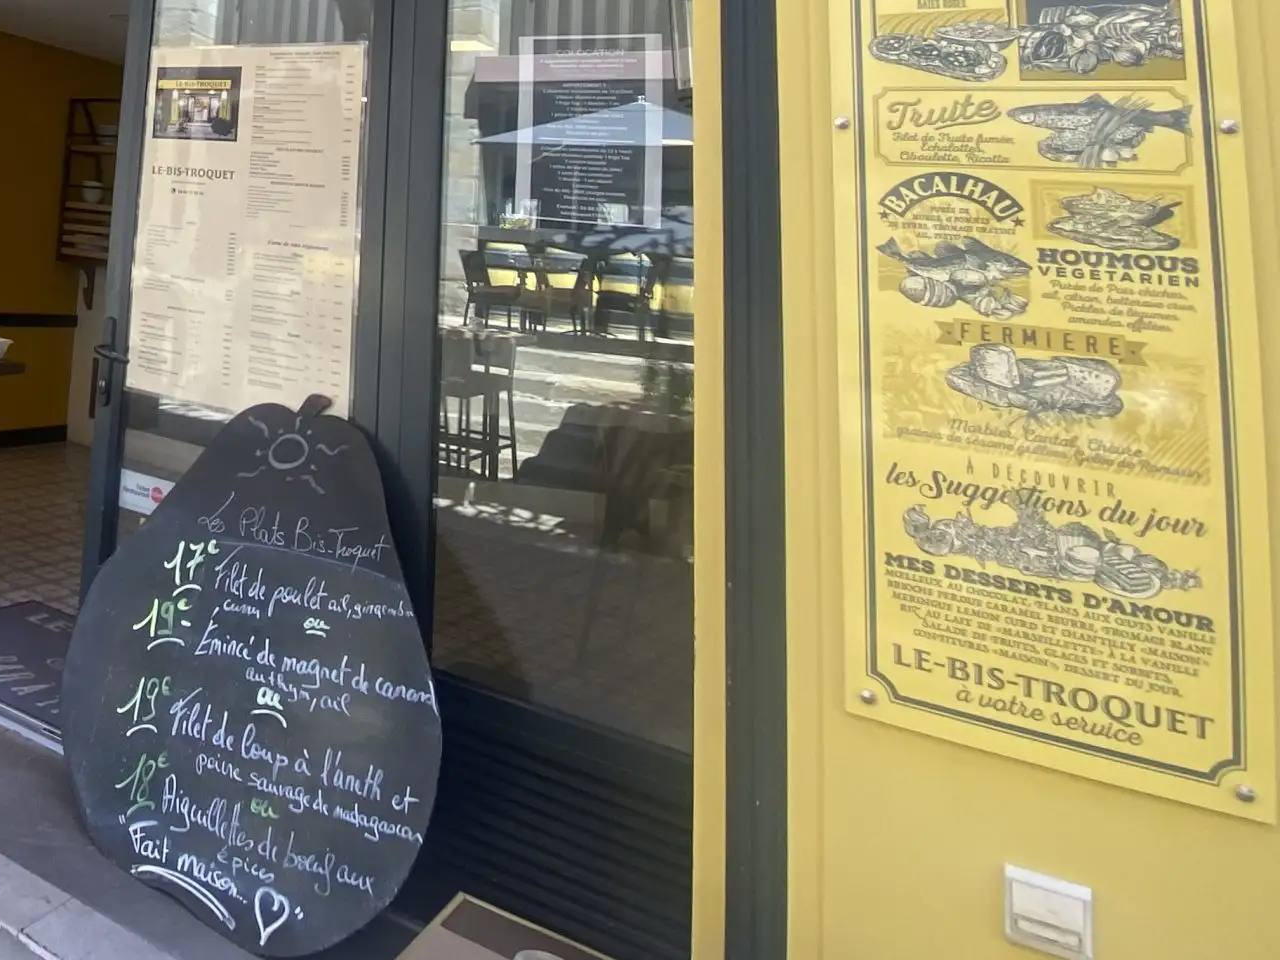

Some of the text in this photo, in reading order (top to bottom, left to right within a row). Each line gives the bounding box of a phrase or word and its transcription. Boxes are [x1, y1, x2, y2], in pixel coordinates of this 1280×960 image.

[886, 94, 1002, 130] Truite
[921, 132, 935, 144] de
[152, 165, 236, 181] LE-BIS-TROQUET
[883, 175, 1019, 217] BACALHAU
[1036, 247, 1200, 274] HOUMOUS
[1037, 265, 1199, 288] VEGETARIEN
[959, 323, 1122, 356] FERMIERE
[885, 462, 1207, 538] les Suggestions du jour
[239, 505, 286, 547] Plats
[293, 517, 391, 574] Bis-Troquet
[214, 544, 246, 598] Filet
[247, 570, 266, 602] de
[268, 586, 322, 618] poulet
[884, 552, 1216, 633] MES DESSERTS D'AMOUR
[925, 610, 941, 619] AU
[944, 616, 973, 626] LAIT
[977, 621, 992, 631] DE
[937, 591, 983, 606] PERDUE
[986, 602, 1043, 620] CARAMEL
[947, 583, 962, 591] AU
[1083, 612, 1111, 622] AUX
[1157, 625, 1216, 644] VANILLE
[957, 606, 1001, 622] LEMON
[1042, 625, 1056, 634] ET
[302, 617, 330, 631] ou
[921, 617, 968, 636] SALADE
[972, 631, 988, 640] DE
[1093, 659, 1109, 668] ET
[256, 639, 277, 668] de
[351, 664, 370, 691] de
[374, 676, 439, 717] canard
[892, 642, 1215, 740] LE-BIS-TROQUET
[1064, 664, 1121, 683] DESSERT
[1124, 678, 1143, 688] DU
[256, 686, 284, 711] ou
[320, 692, 352, 717] ail
[956, 687, 1144, 745] à votre service
[169, 688, 420, 814] Filet de loup à l'aneth et
[196, 750, 242, 783] poivre
[248, 770, 312, 813] sauvage
[312, 789, 329, 816] de
[249, 797, 280, 819] ou
[162, 773, 254, 852] Aiguillettes
[257, 825, 278, 862] de
[337, 864, 375, 895] aux
[216, 847, 276, 883] épices
